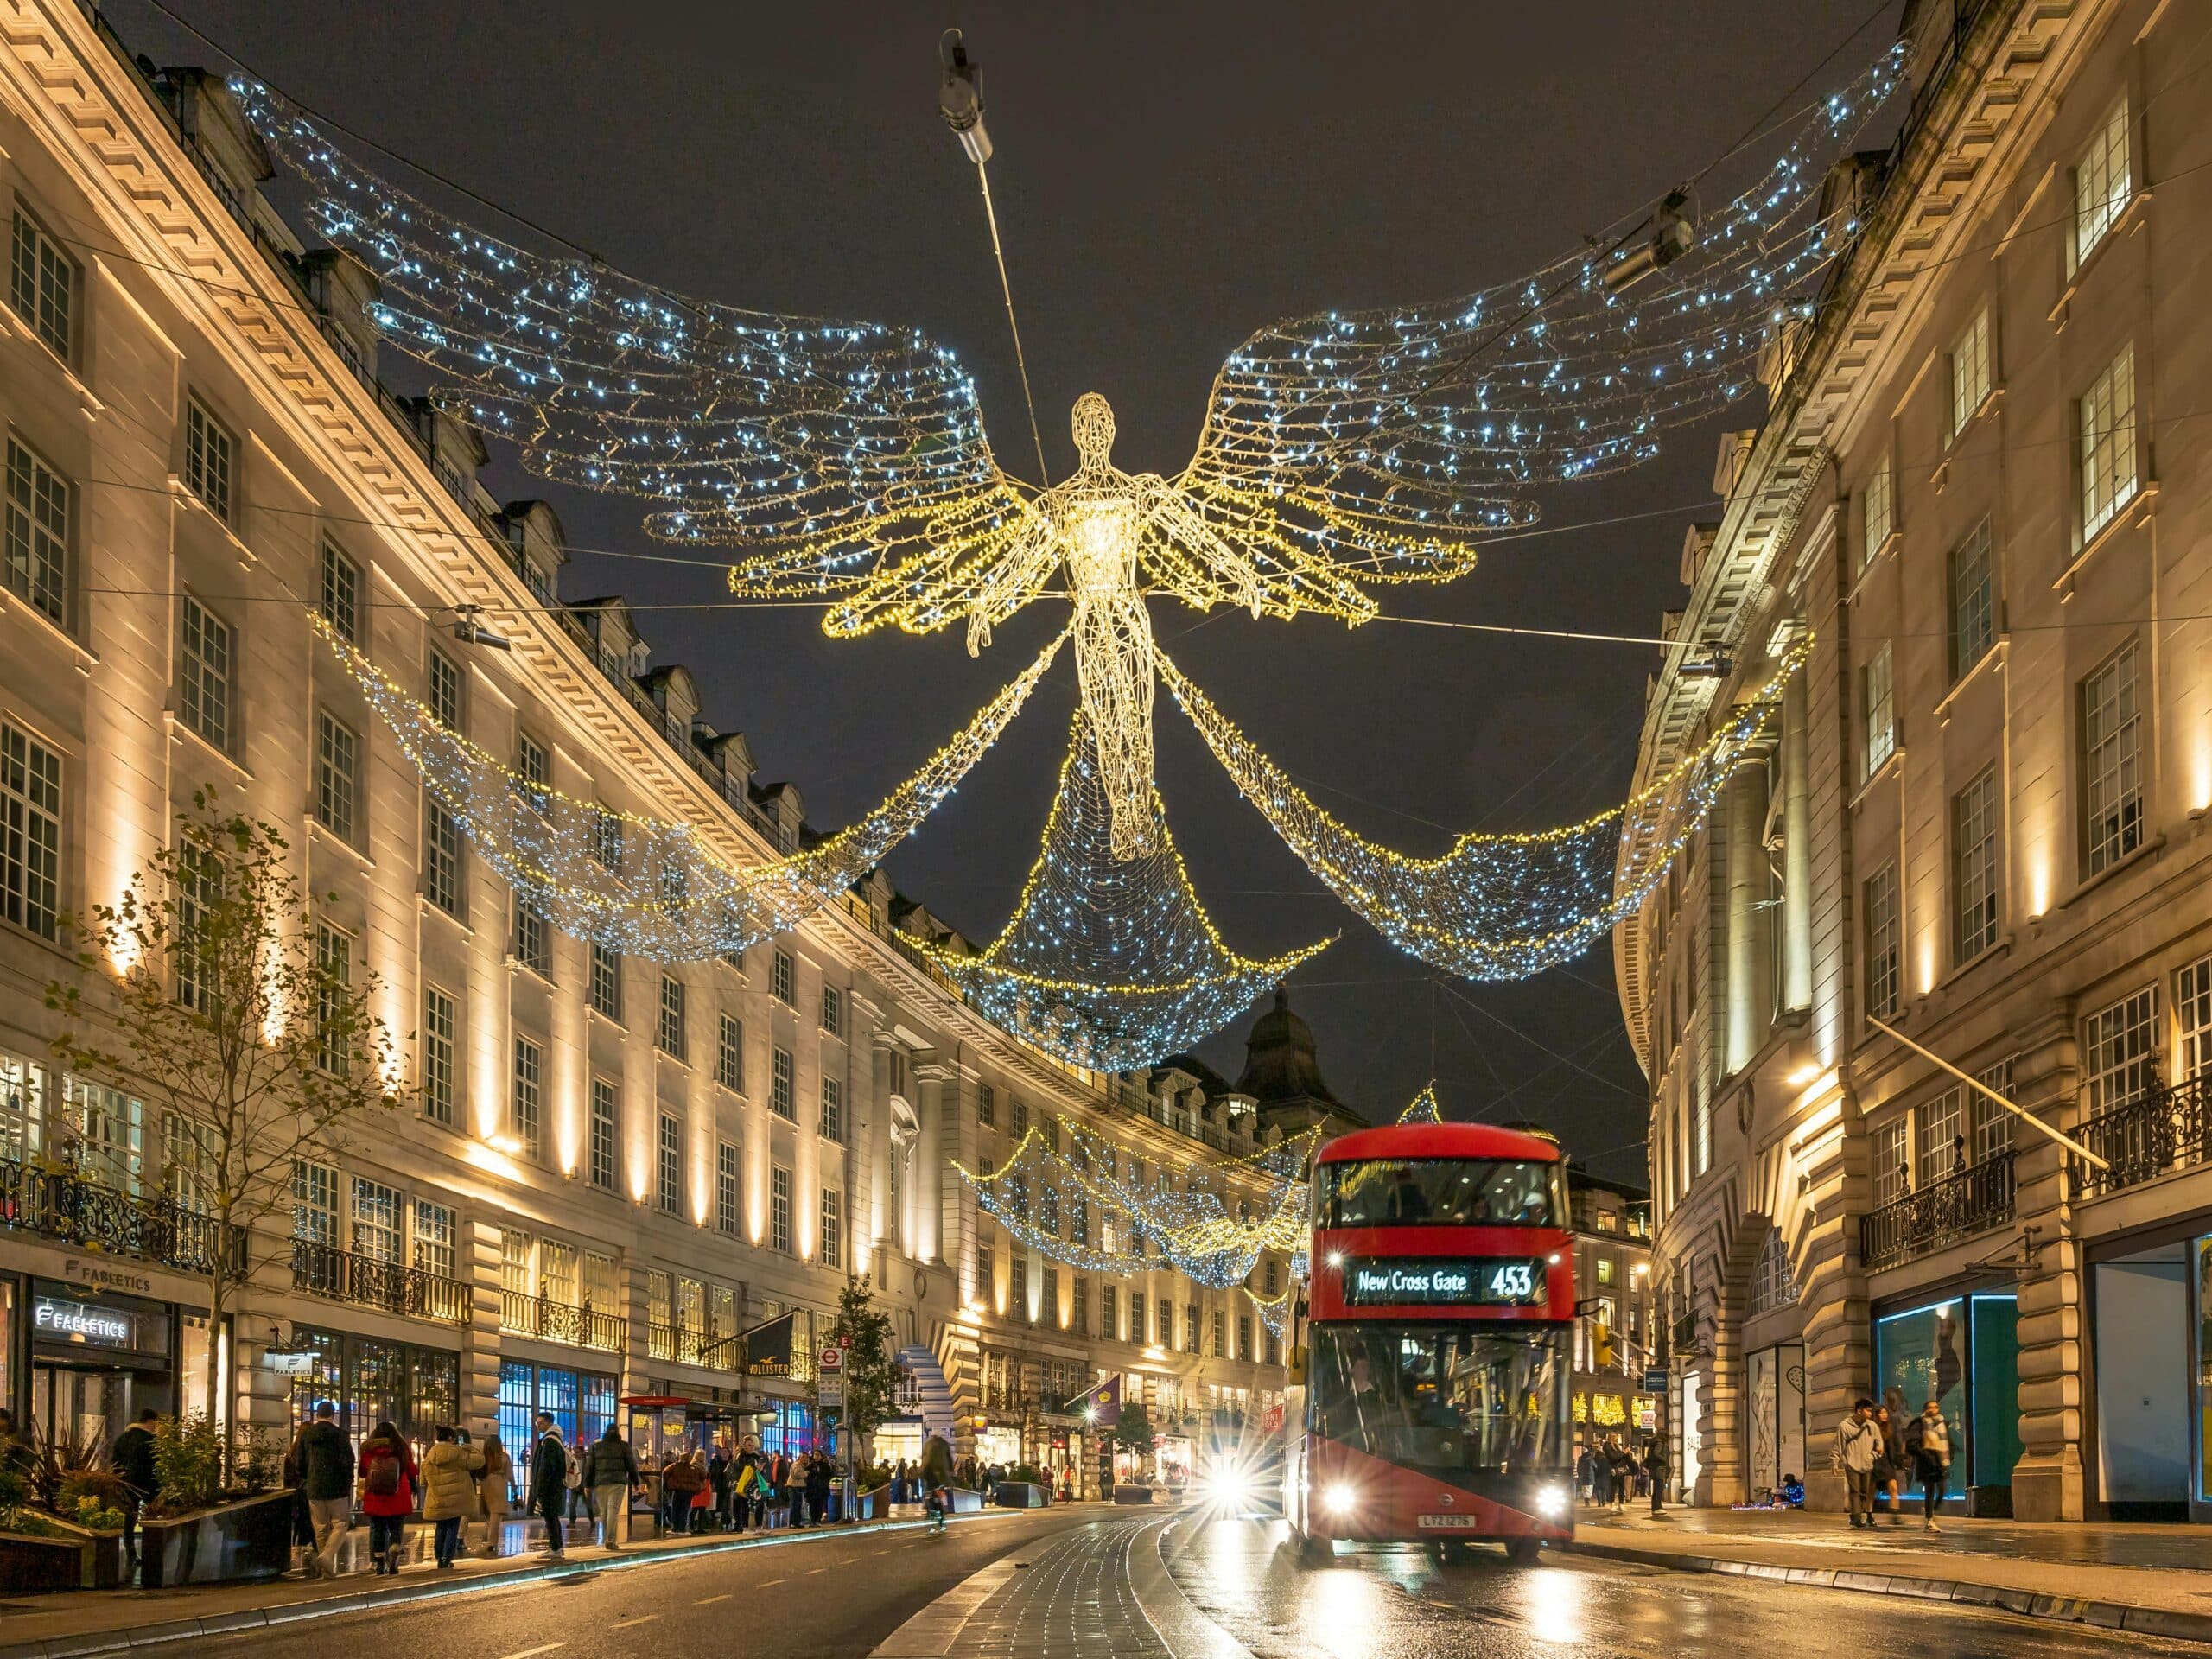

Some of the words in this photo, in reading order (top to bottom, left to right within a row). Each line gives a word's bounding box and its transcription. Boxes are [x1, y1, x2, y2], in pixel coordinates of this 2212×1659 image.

[82, 1267, 151, 1292] FABLETICS
[1358, 1270, 1389, 1291] New
[1391, 1270, 1430, 1291] Cross
[1432, 1270, 1468, 1291] Gate
[1490, 1265, 1532, 1296] 453
[54, 1313, 125, 1338] FABLETICS
[842, 1337, 849, 1347] E
